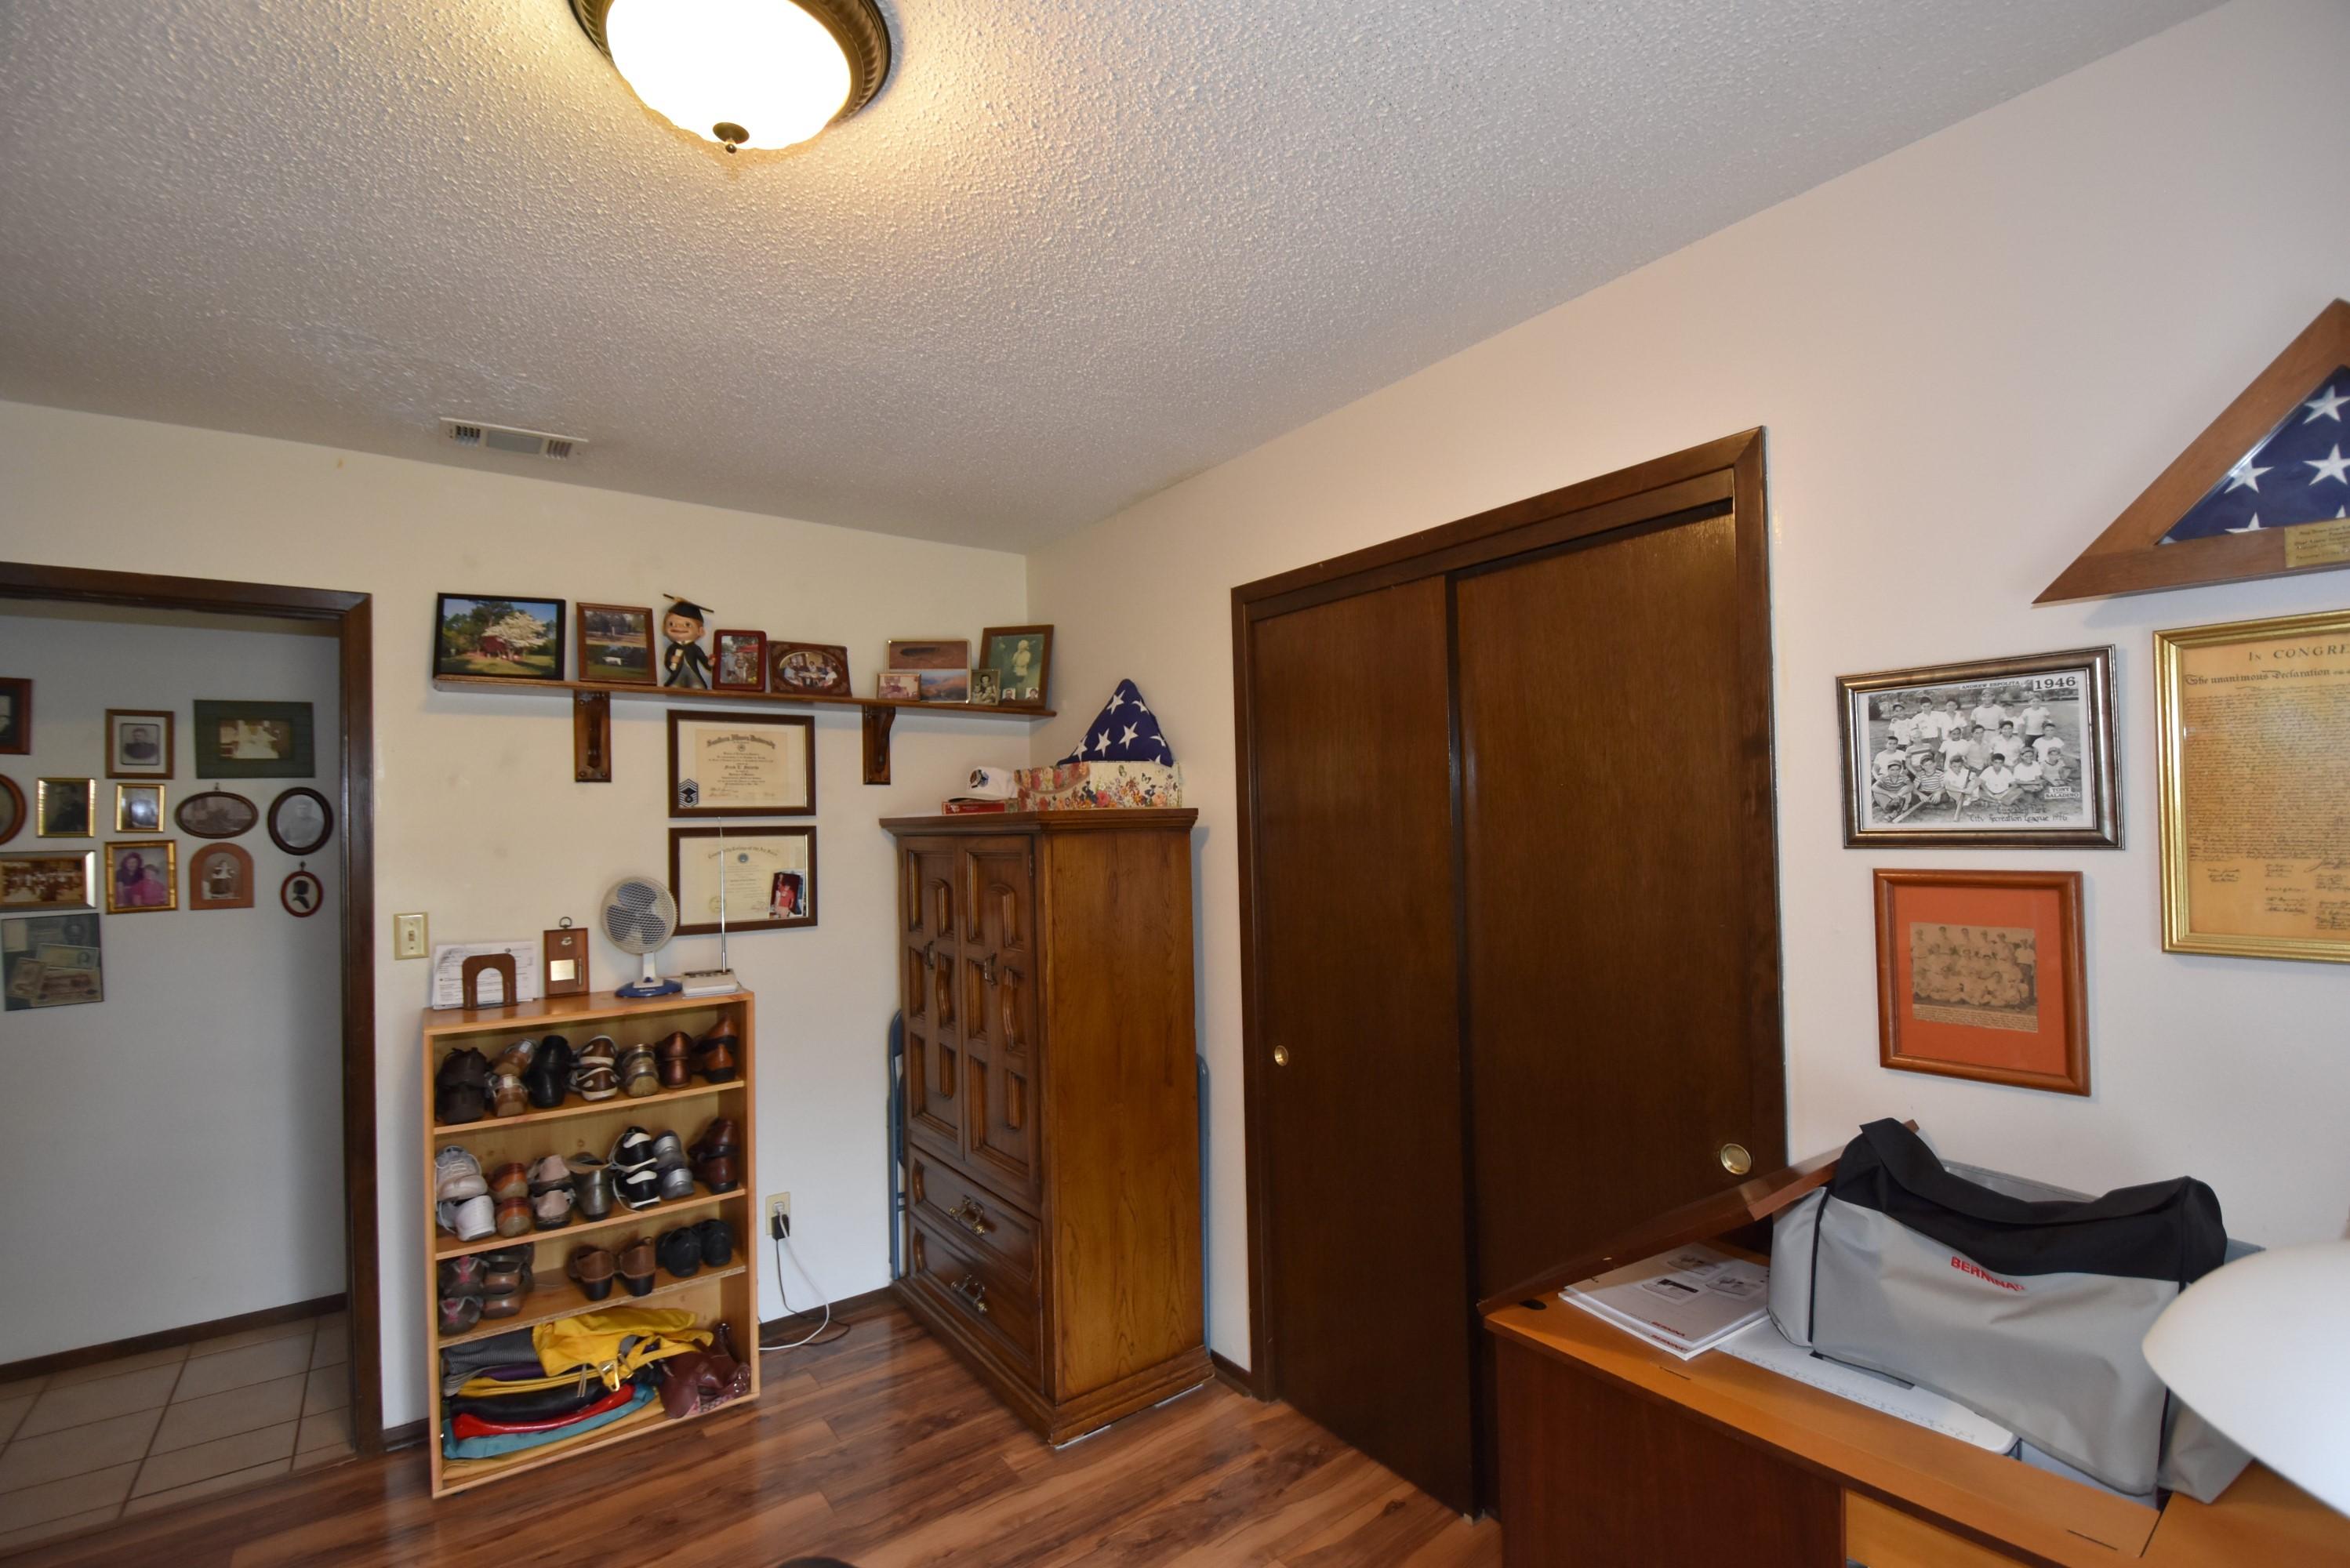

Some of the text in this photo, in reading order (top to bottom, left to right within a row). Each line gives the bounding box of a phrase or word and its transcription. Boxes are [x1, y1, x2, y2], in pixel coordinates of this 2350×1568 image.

[2035, 676, 2076, 690] 1946
[2184, 673, 2209, 685] The
[2210, 674, 2268, 684] unanimous
[2262, 670, 2330, 680] Declaration
[2024, 814, 2049, 823] League
[1951, 1256, 2025, 1291] BERNINA
